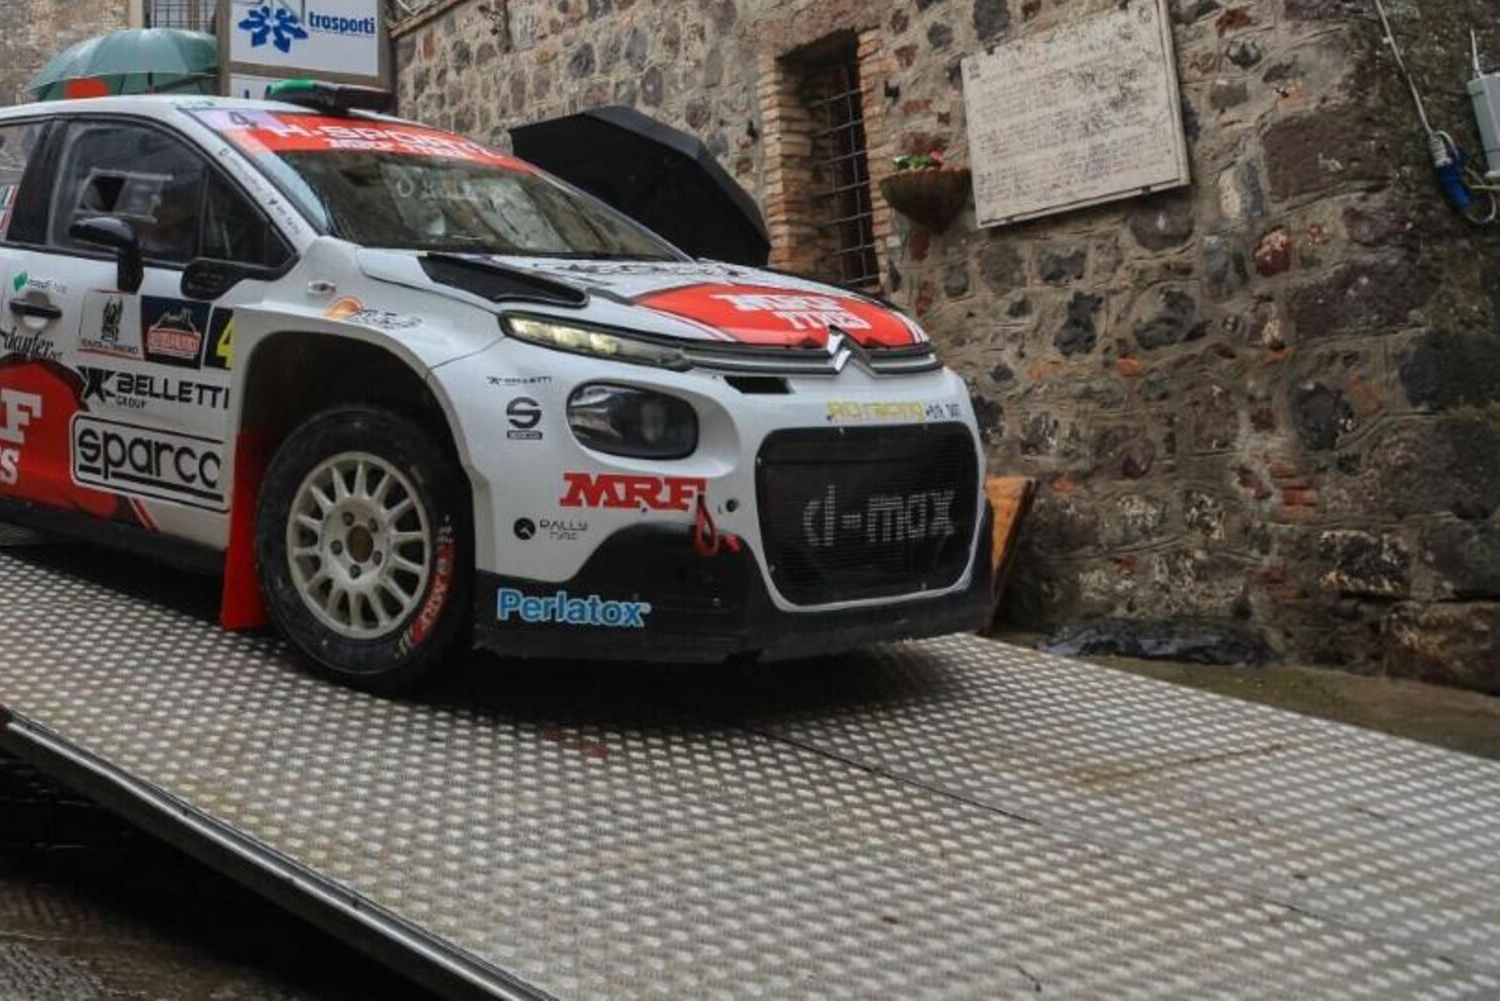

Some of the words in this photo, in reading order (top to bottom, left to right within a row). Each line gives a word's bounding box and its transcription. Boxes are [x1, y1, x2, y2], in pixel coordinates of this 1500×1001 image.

[307, 10, 376, 36] trasporti
[117, 372, 230, 410] BELLETTI
[559, 472, 707, 512] MRF
[802, 484, 955, 547] d-max
[497, 588, 646, 627] Perlatox
